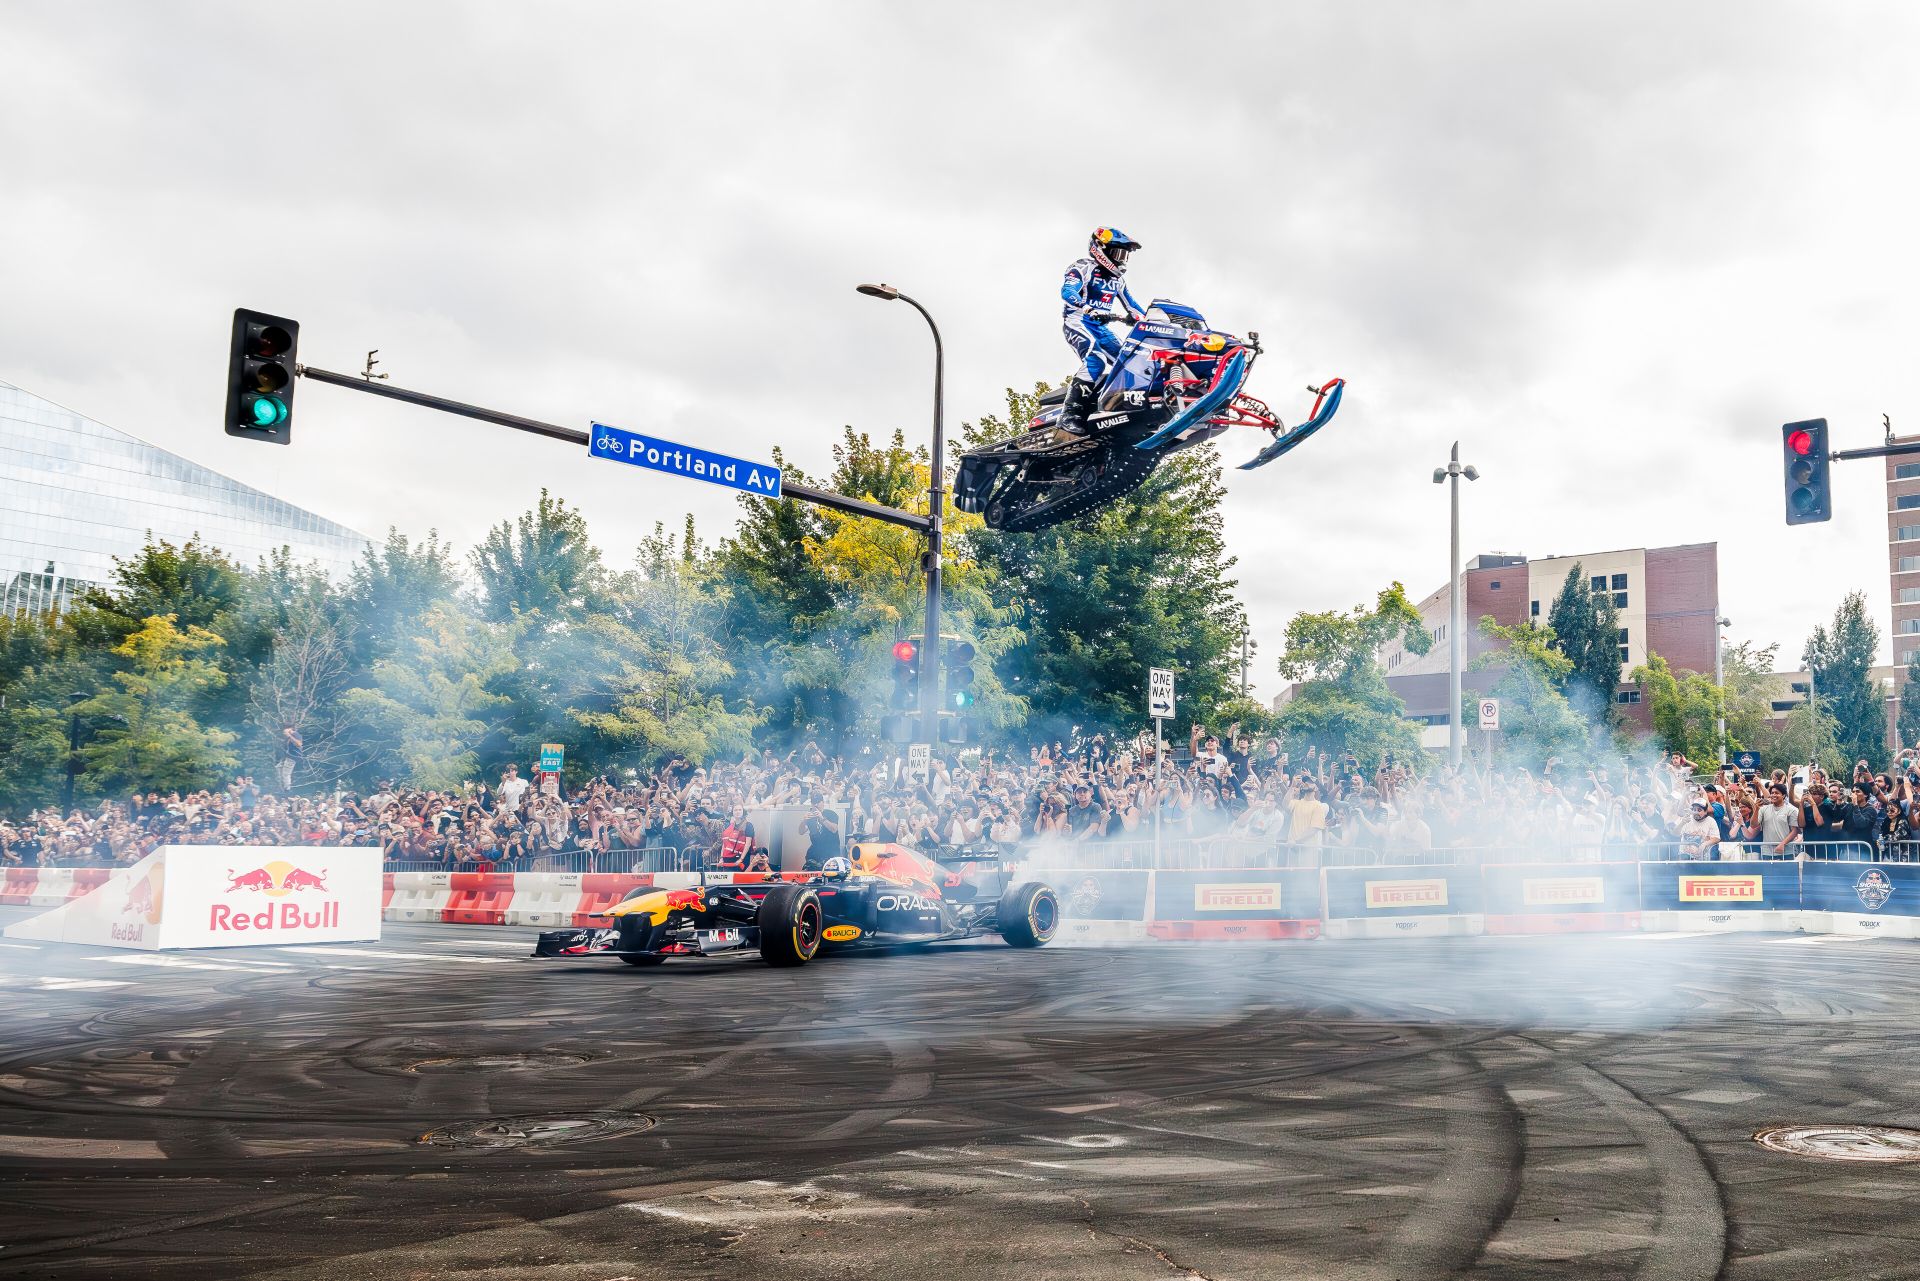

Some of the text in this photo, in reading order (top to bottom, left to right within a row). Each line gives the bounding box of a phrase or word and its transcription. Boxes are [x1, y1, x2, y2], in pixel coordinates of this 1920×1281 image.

[629, 439, 775, 491] Portland Av
[1152, 672, 1171, 686] ONE
[1152, 685, 1171, 699] WAY
[911, 747, 927, 758] ONE
[910, 759, 927, 769] WAY
[1372, 884, 1441, 903] PIRELLI
[1686, 880, 1756, 897] PIRELLI
[1203, 888, 1274, 906] PIRELLI
[210, 902, 338, 931] Red Bull
[112, 922, 143, 942] Red Bull
[709, 928, 740, 943] Mobil
[832, 929, 857, 937] RAUCH
